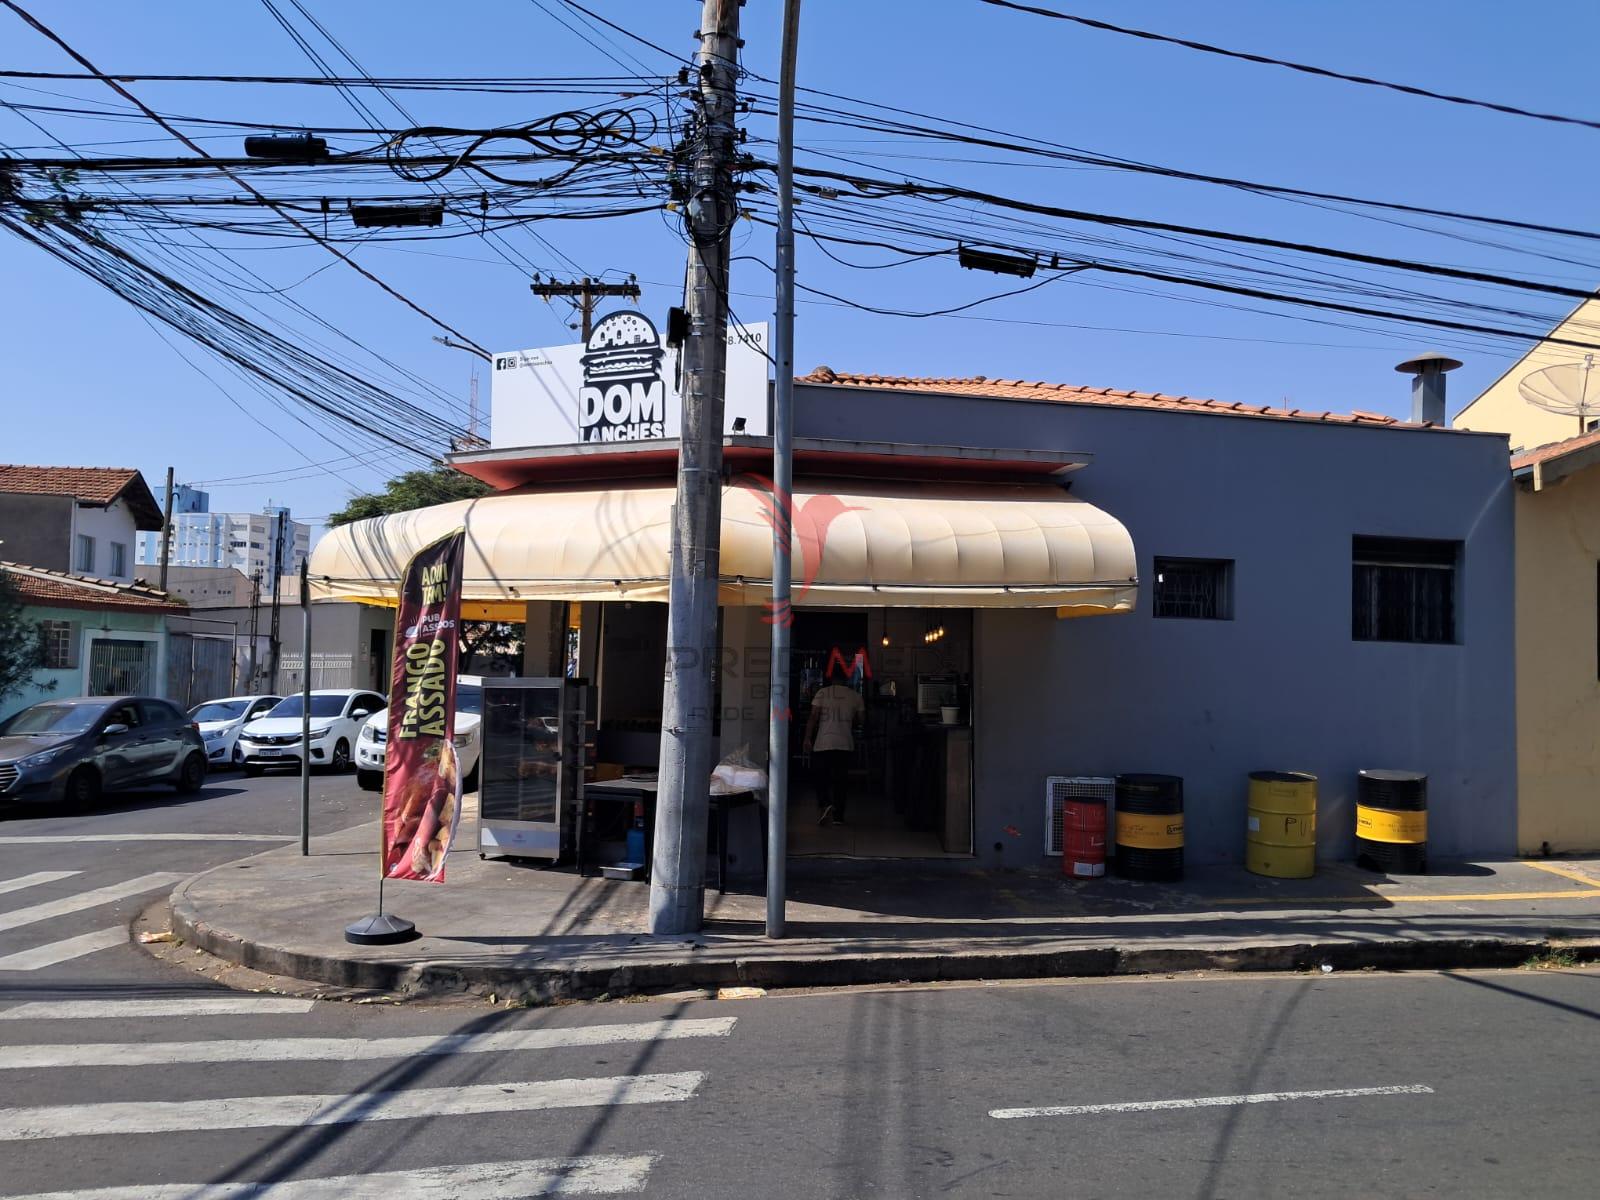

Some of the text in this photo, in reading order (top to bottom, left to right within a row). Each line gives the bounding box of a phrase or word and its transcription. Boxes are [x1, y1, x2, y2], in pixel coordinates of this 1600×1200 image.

[579, 380, 664, 427] DOM
[579, 422, 664, 443] LANCHES
[399, 642, 430, 738] FRANGO
[418, 639, 446, 737] ASSADO
